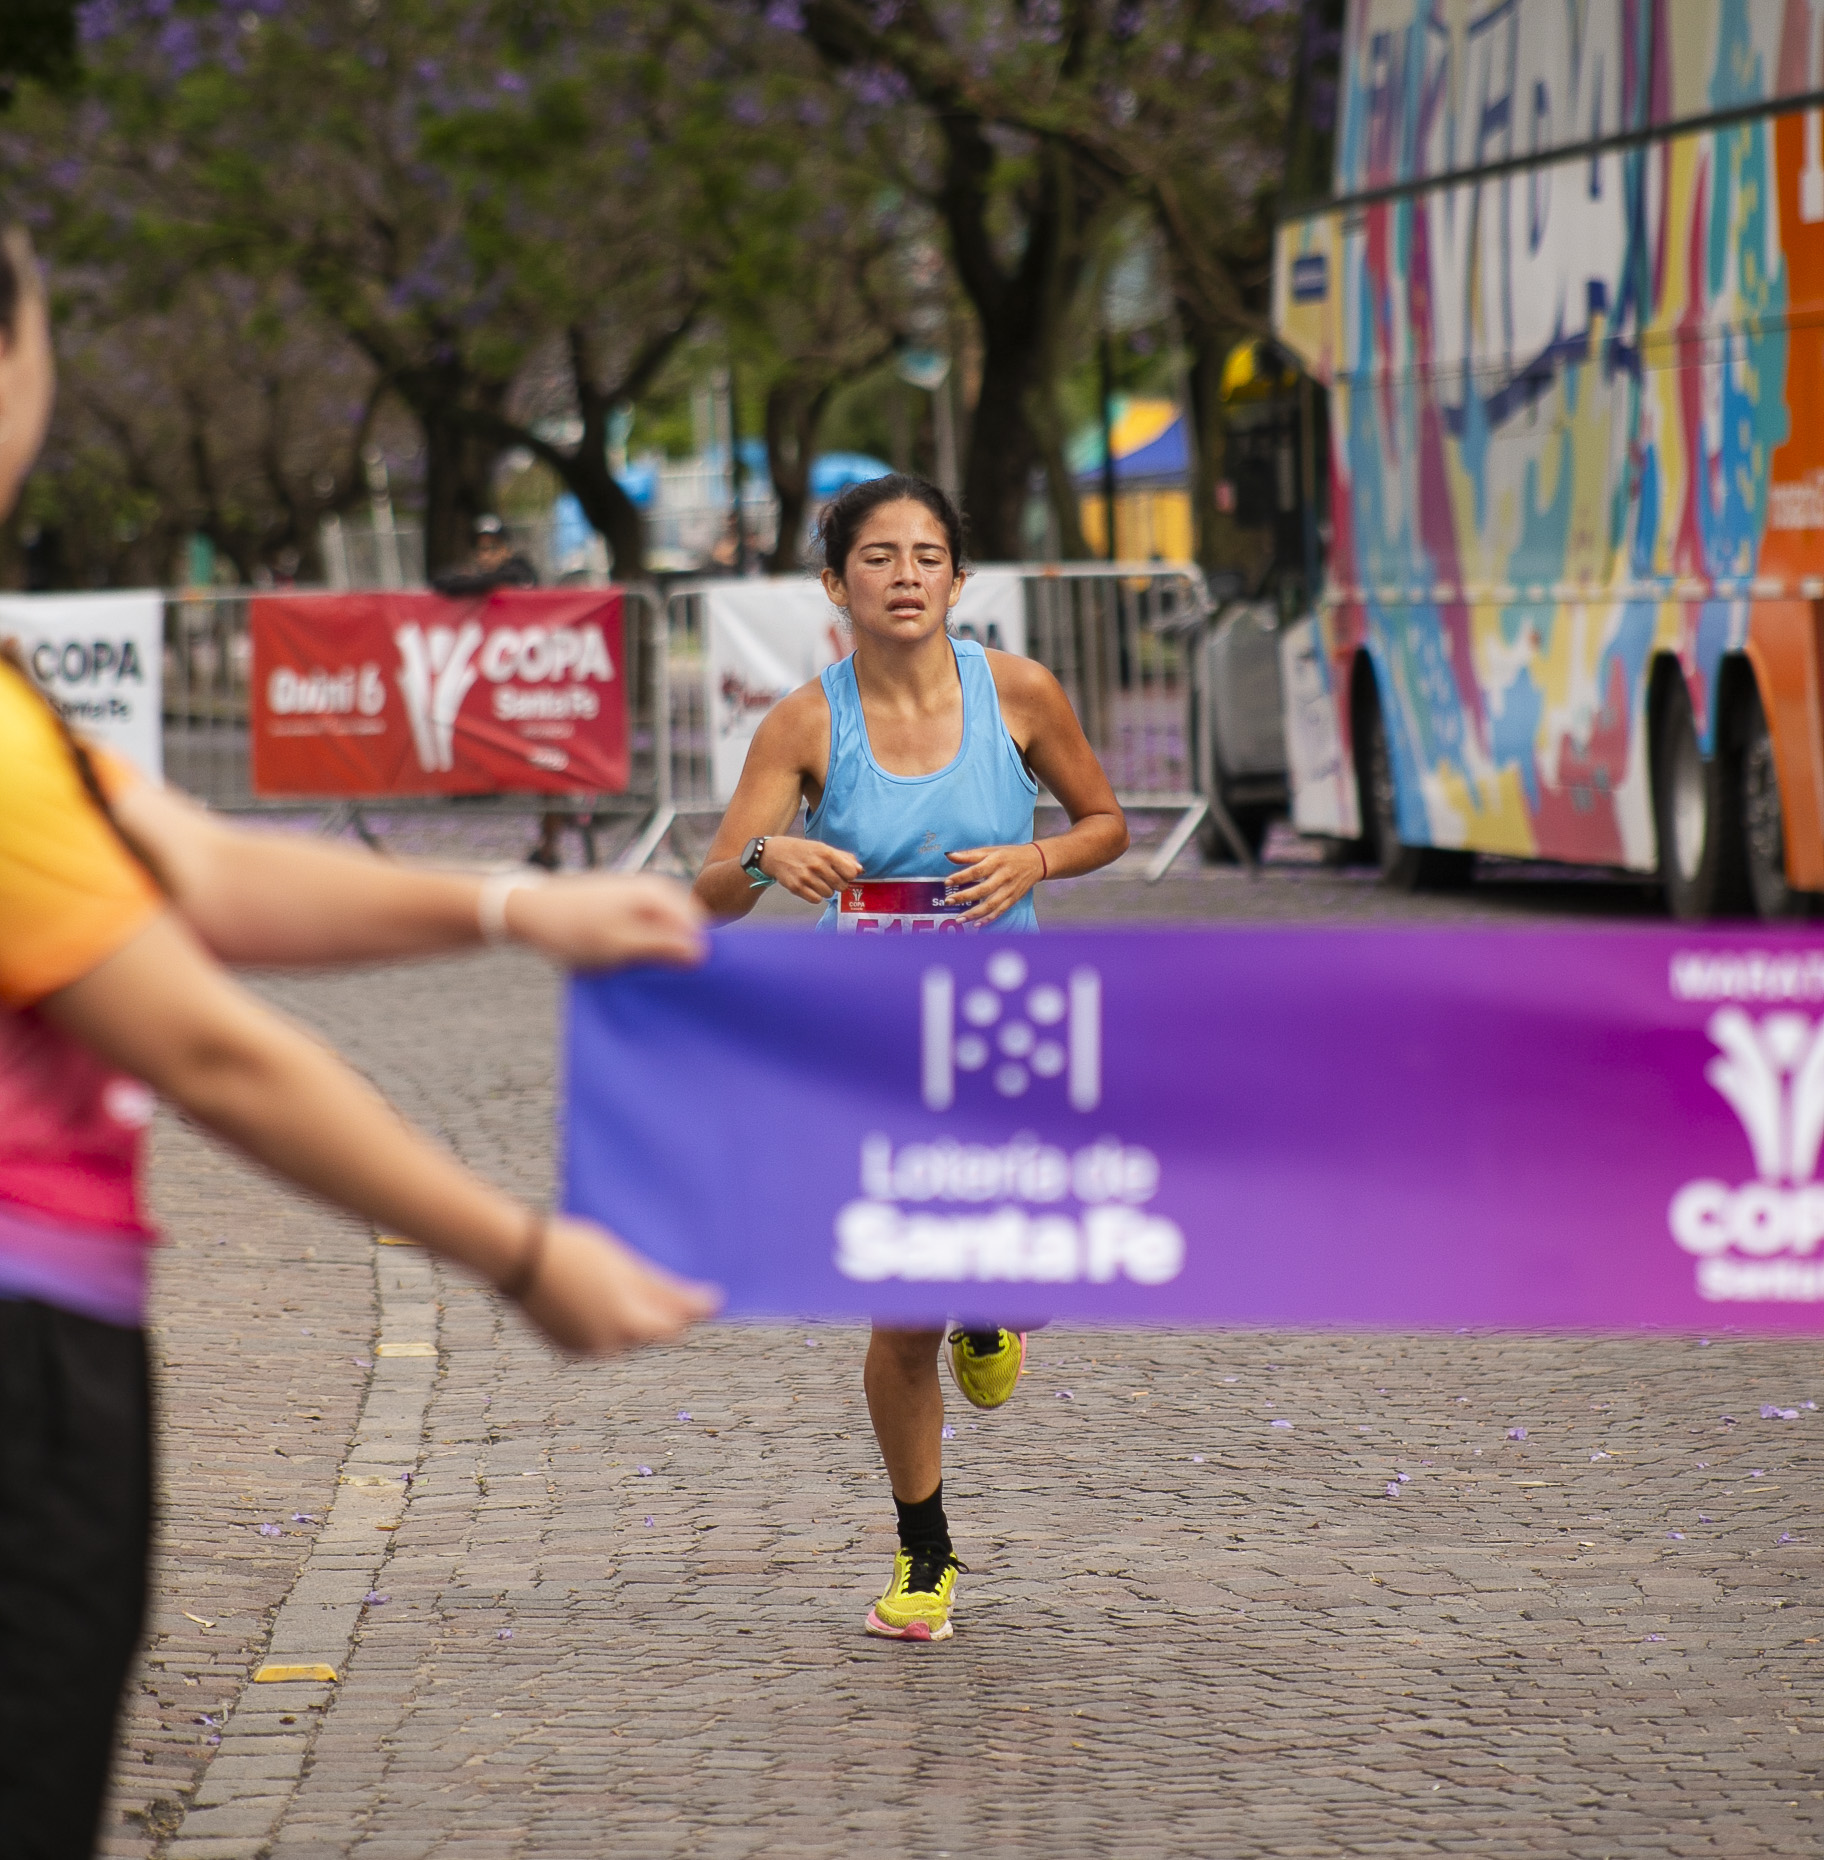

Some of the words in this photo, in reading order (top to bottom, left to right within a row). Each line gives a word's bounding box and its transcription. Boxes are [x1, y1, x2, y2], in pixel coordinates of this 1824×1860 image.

[32, 641, 143, 683] COPA
[481, 626, 614, 682] COPA
[357, 663, 386, 716] 6
[492, 687, 569, 721] Santa
[571, 685, 600, 720] Fe
[1073, 1139, 1160, 1203] de
[836, 1201, 1079, 1284] Santa
[1083, 1203, 1186, 1285] Fe
